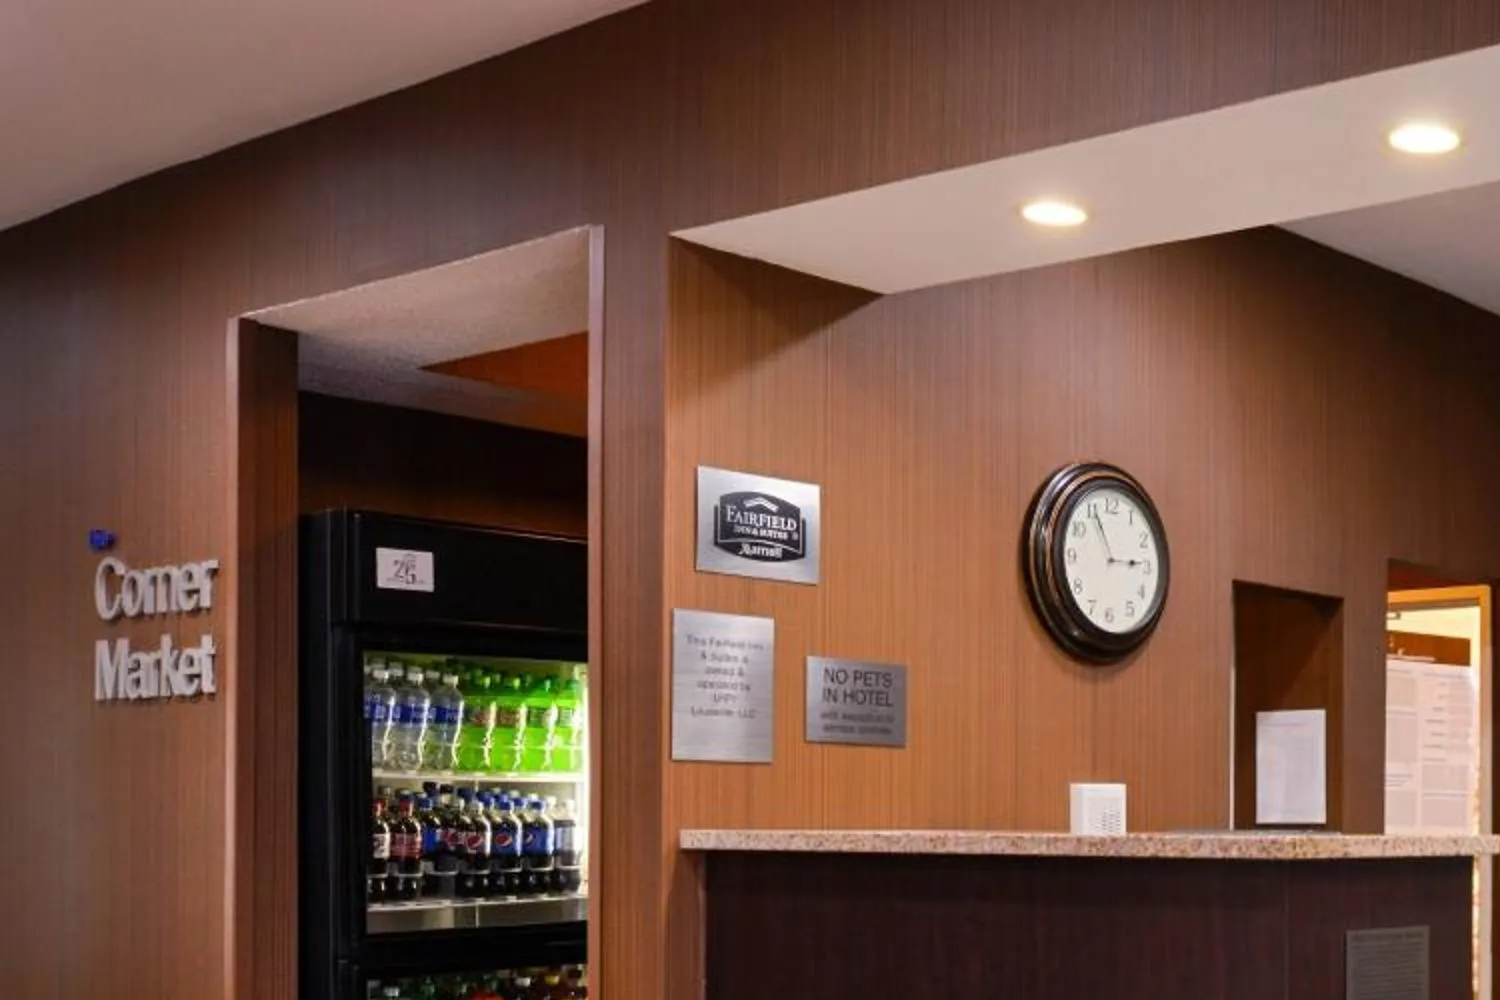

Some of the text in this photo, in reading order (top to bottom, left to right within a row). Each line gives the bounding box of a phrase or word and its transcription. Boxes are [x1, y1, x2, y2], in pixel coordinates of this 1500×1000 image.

[1105, 498, 1119, 515] 12
[726, 505, 797, 531] FAIRFIELD
[1128, 510, 1134, 526] 1
[1072, 521, 1086, 537] 10
[1139, 532, 1148, 548] 2
[1067, 548, 1077, 563] 9
[1143, 560, 1152, 575] 3
[95, 556, 219, 620] Corner
[1073, 579, 1083, 594] 8
[1138, 584, 1145, 599] 4
[1088, 600, 1097, 615] 7
[1105, 607, 1114, 623] 6
[1126, 601, 1135, 617] 5
[95, 634, 217, 700] Market
[824, 667, 892, 688] NO PETS
[823, 688, 893, 707] IN HOTEL
